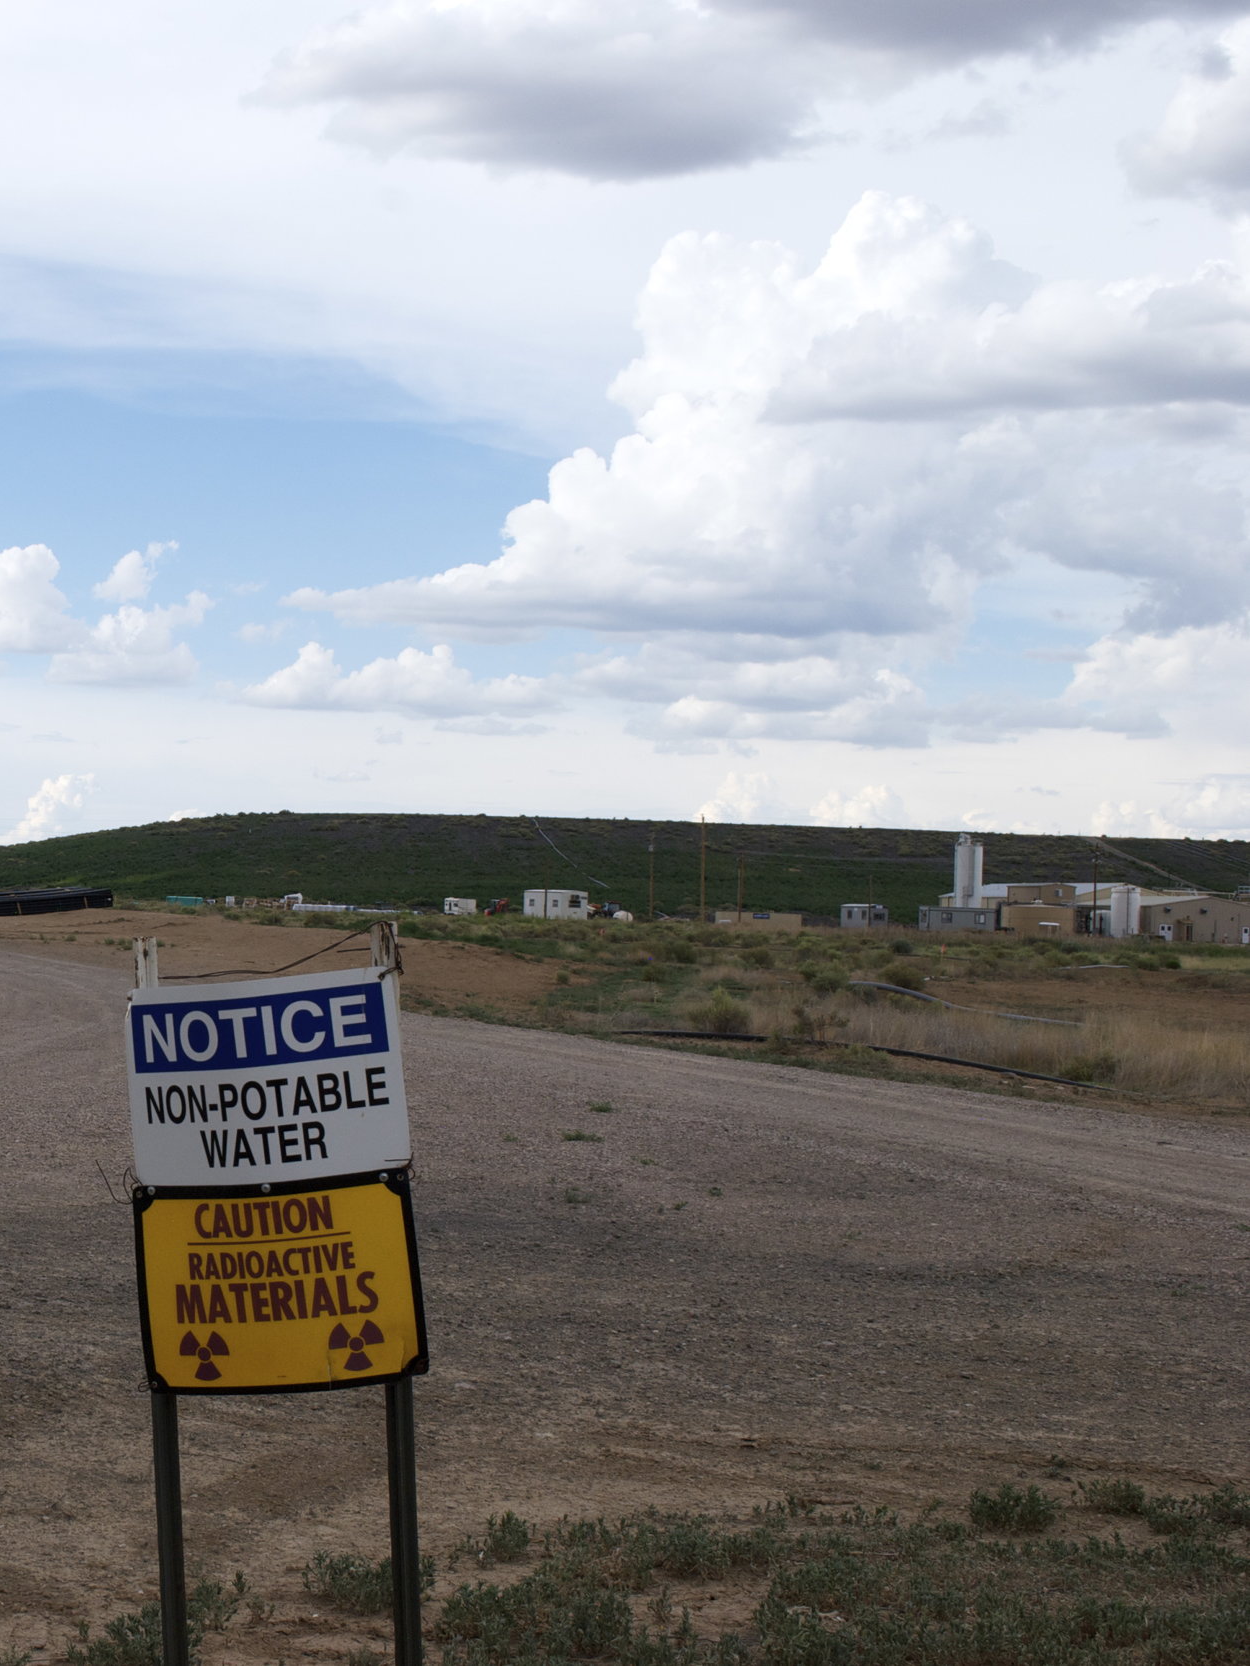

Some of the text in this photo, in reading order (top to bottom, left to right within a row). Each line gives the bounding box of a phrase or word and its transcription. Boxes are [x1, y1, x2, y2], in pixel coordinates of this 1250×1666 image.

[142, 994, 372, 1063] NOTICE
[145, 1066, 390, 1124] NON-POTABLE
[200, 1121, 328, 1168] WATER
[194, 1195, 334, 1239] CAUTION
[188, 1241, 356, 1281] RADIOACTIVE
[176, 1271, 379, 1324] MATERIALS
